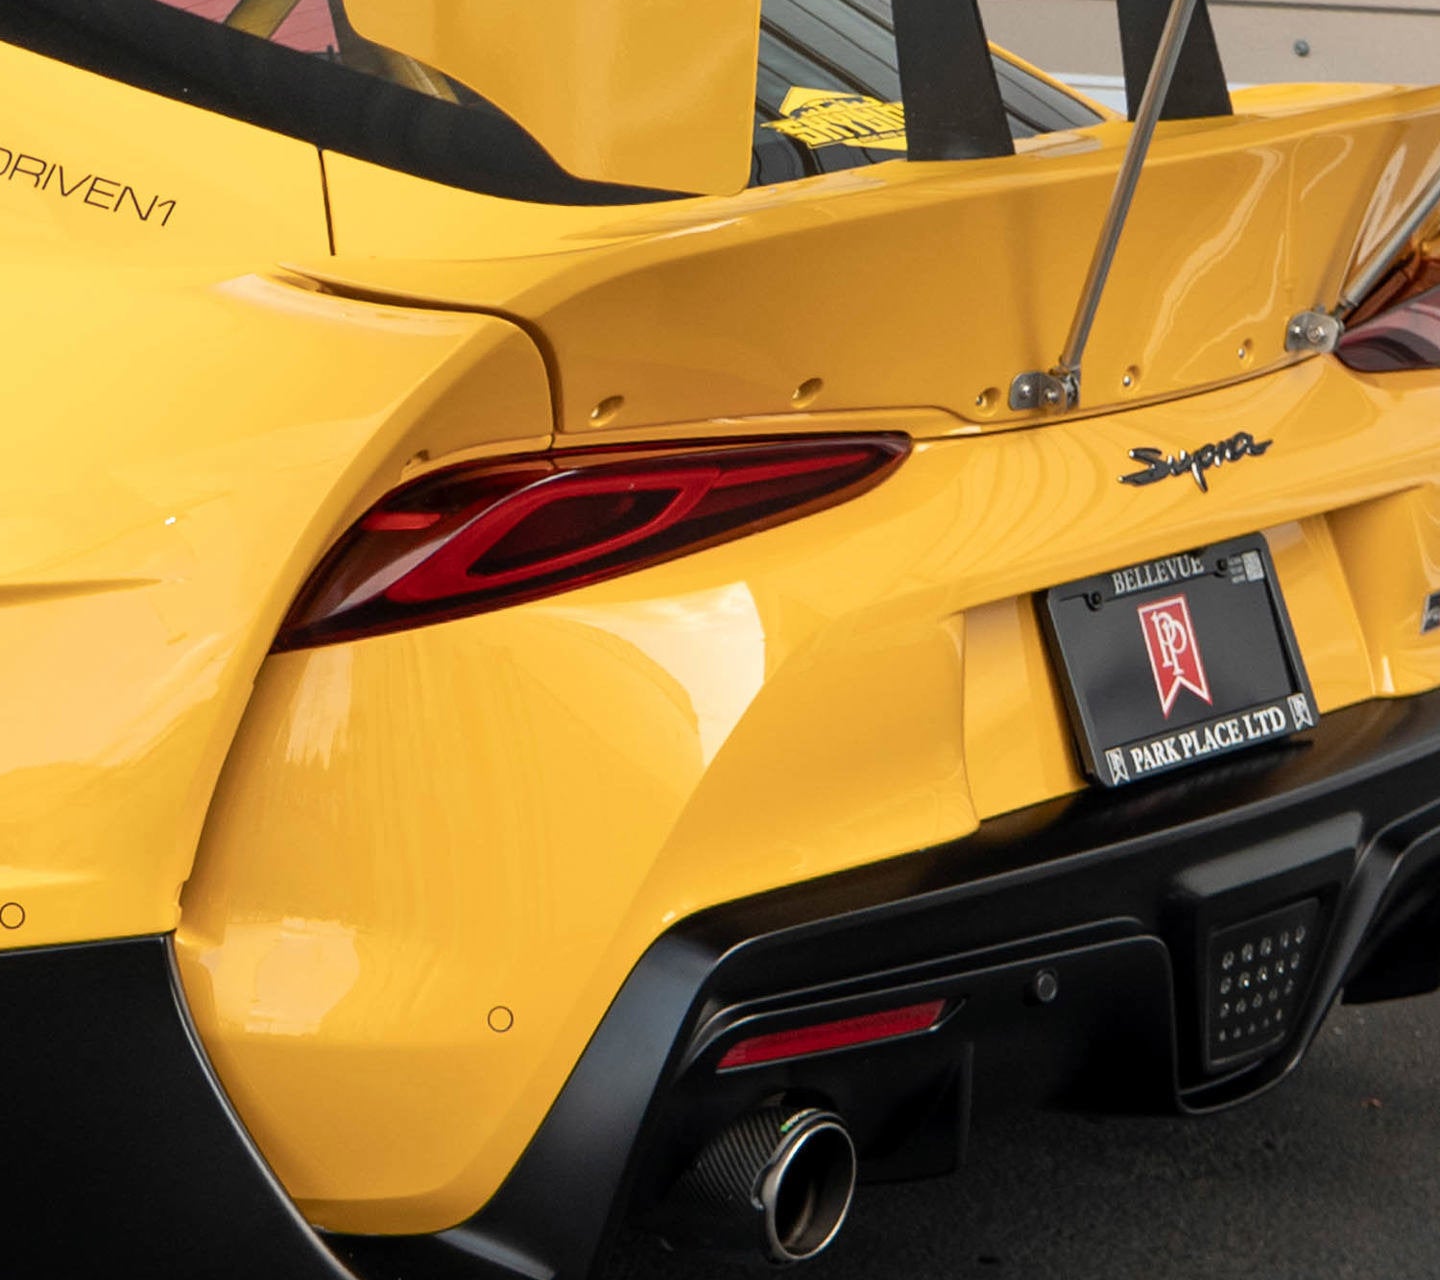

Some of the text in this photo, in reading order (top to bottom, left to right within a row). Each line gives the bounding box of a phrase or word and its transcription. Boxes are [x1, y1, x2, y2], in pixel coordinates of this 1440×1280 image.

[1117, 431, 1273, 493] Supra
[1112, 553, 1205, 595] BELLEVUE
[1130, 737, 1182, 773] PARK
[1179, 718, 1244, 759] PLACE
[1242, 706, 1286, 739] LTD
